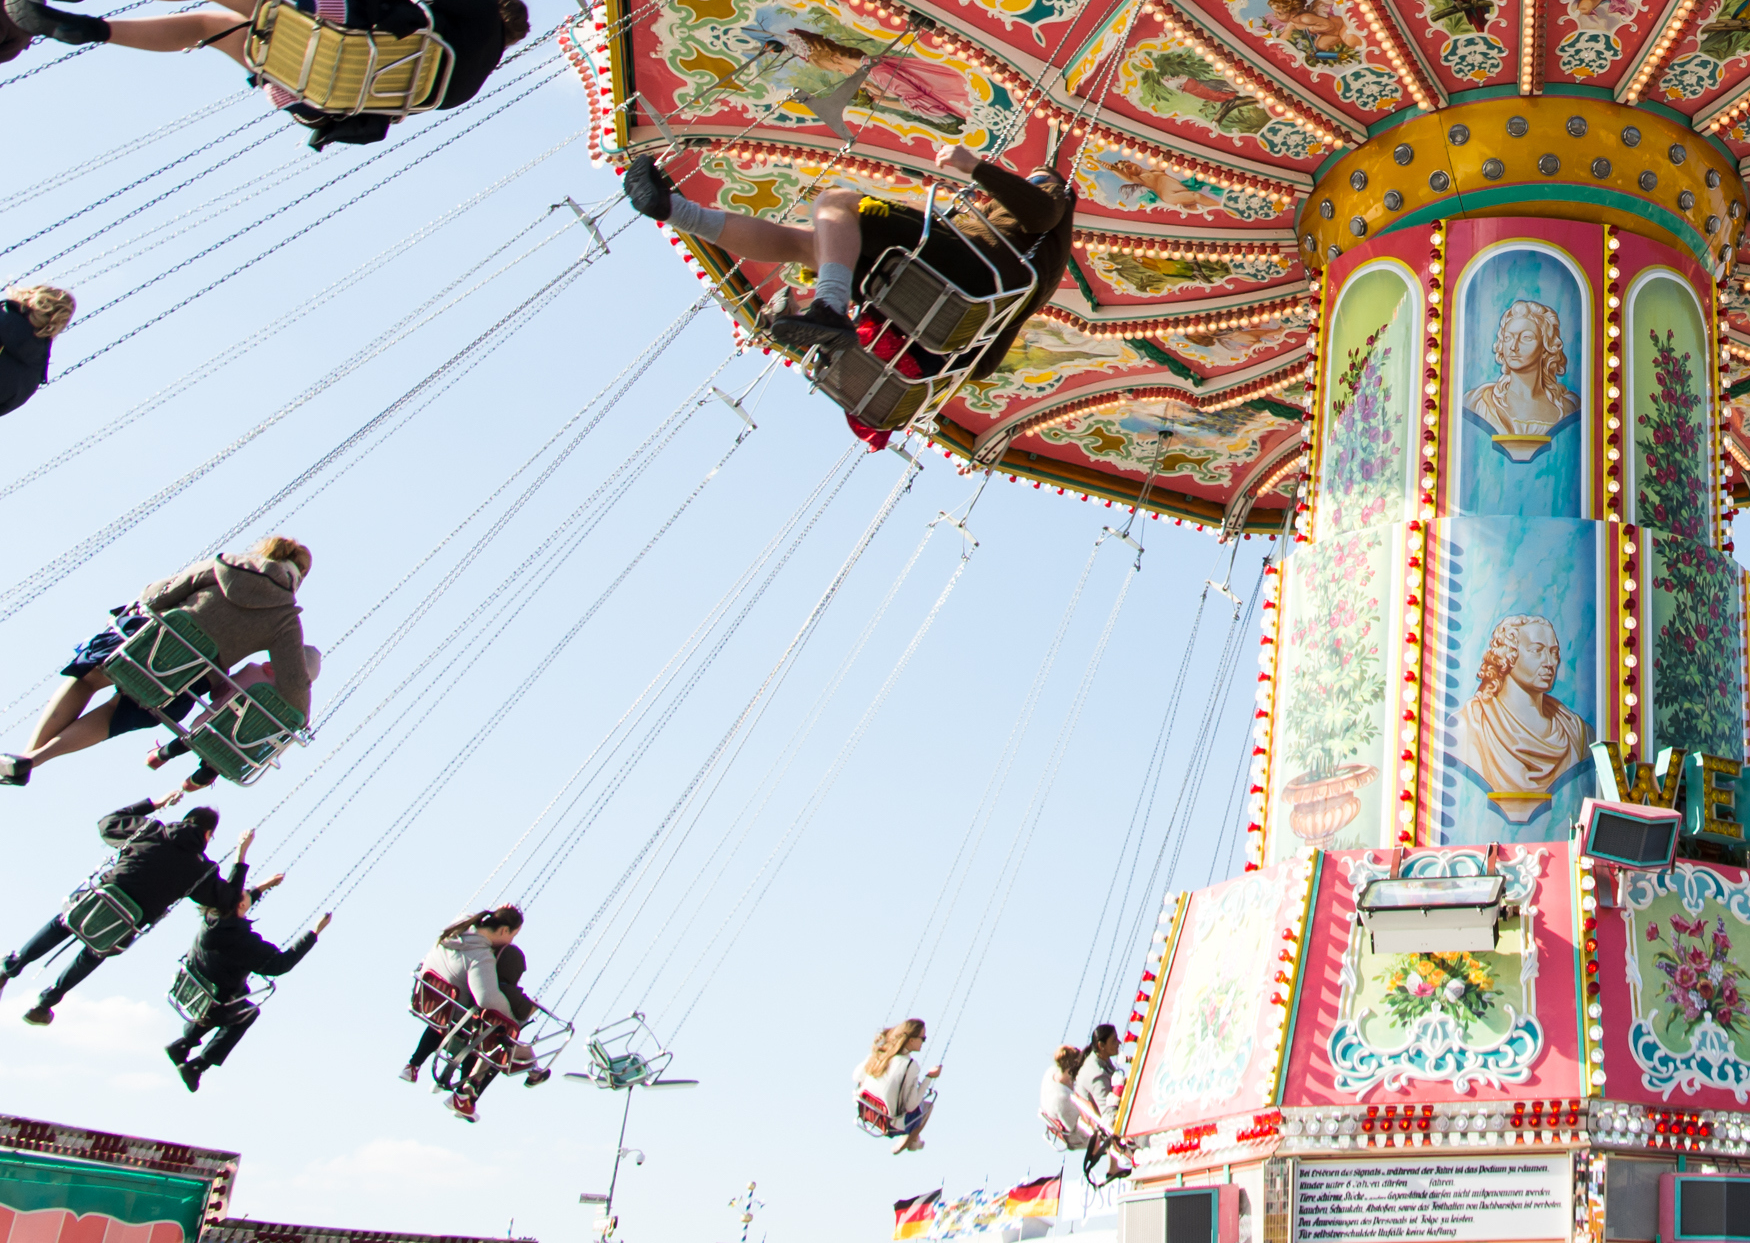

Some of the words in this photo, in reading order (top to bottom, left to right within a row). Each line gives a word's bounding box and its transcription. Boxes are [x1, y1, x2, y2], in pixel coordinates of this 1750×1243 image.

[1386, 1167, 1420, 1175] während
[1421, 1167, 1434, 1175] der
[1455, 1165, 1464, 1174] ist
[1464, 1165, 1478, 1173] das
[1508, 1165, 1517, 1175] zu
[1300, 1181, 1324, 1190] Kinder
[1326, 1180, 1344, 1189] unter
[1382, 1179, 1408, 1187] dürfen
[1428, 1189, 1452, 1199] dürfen
[1453, 1188, 1470, 1197] nicht
[1418, 1203, 1430, 1211] das
[1524, 1200, 1533, 1209] ist
[1298, 1217, 1311, 1227] Den
[1360, 1217, 1372, 1225] des
[1409, 1215, 1418, 1224] ist
[1298, 1229, 1312, 1239] Für
[1406, 1226, 1426, 1236] keine
